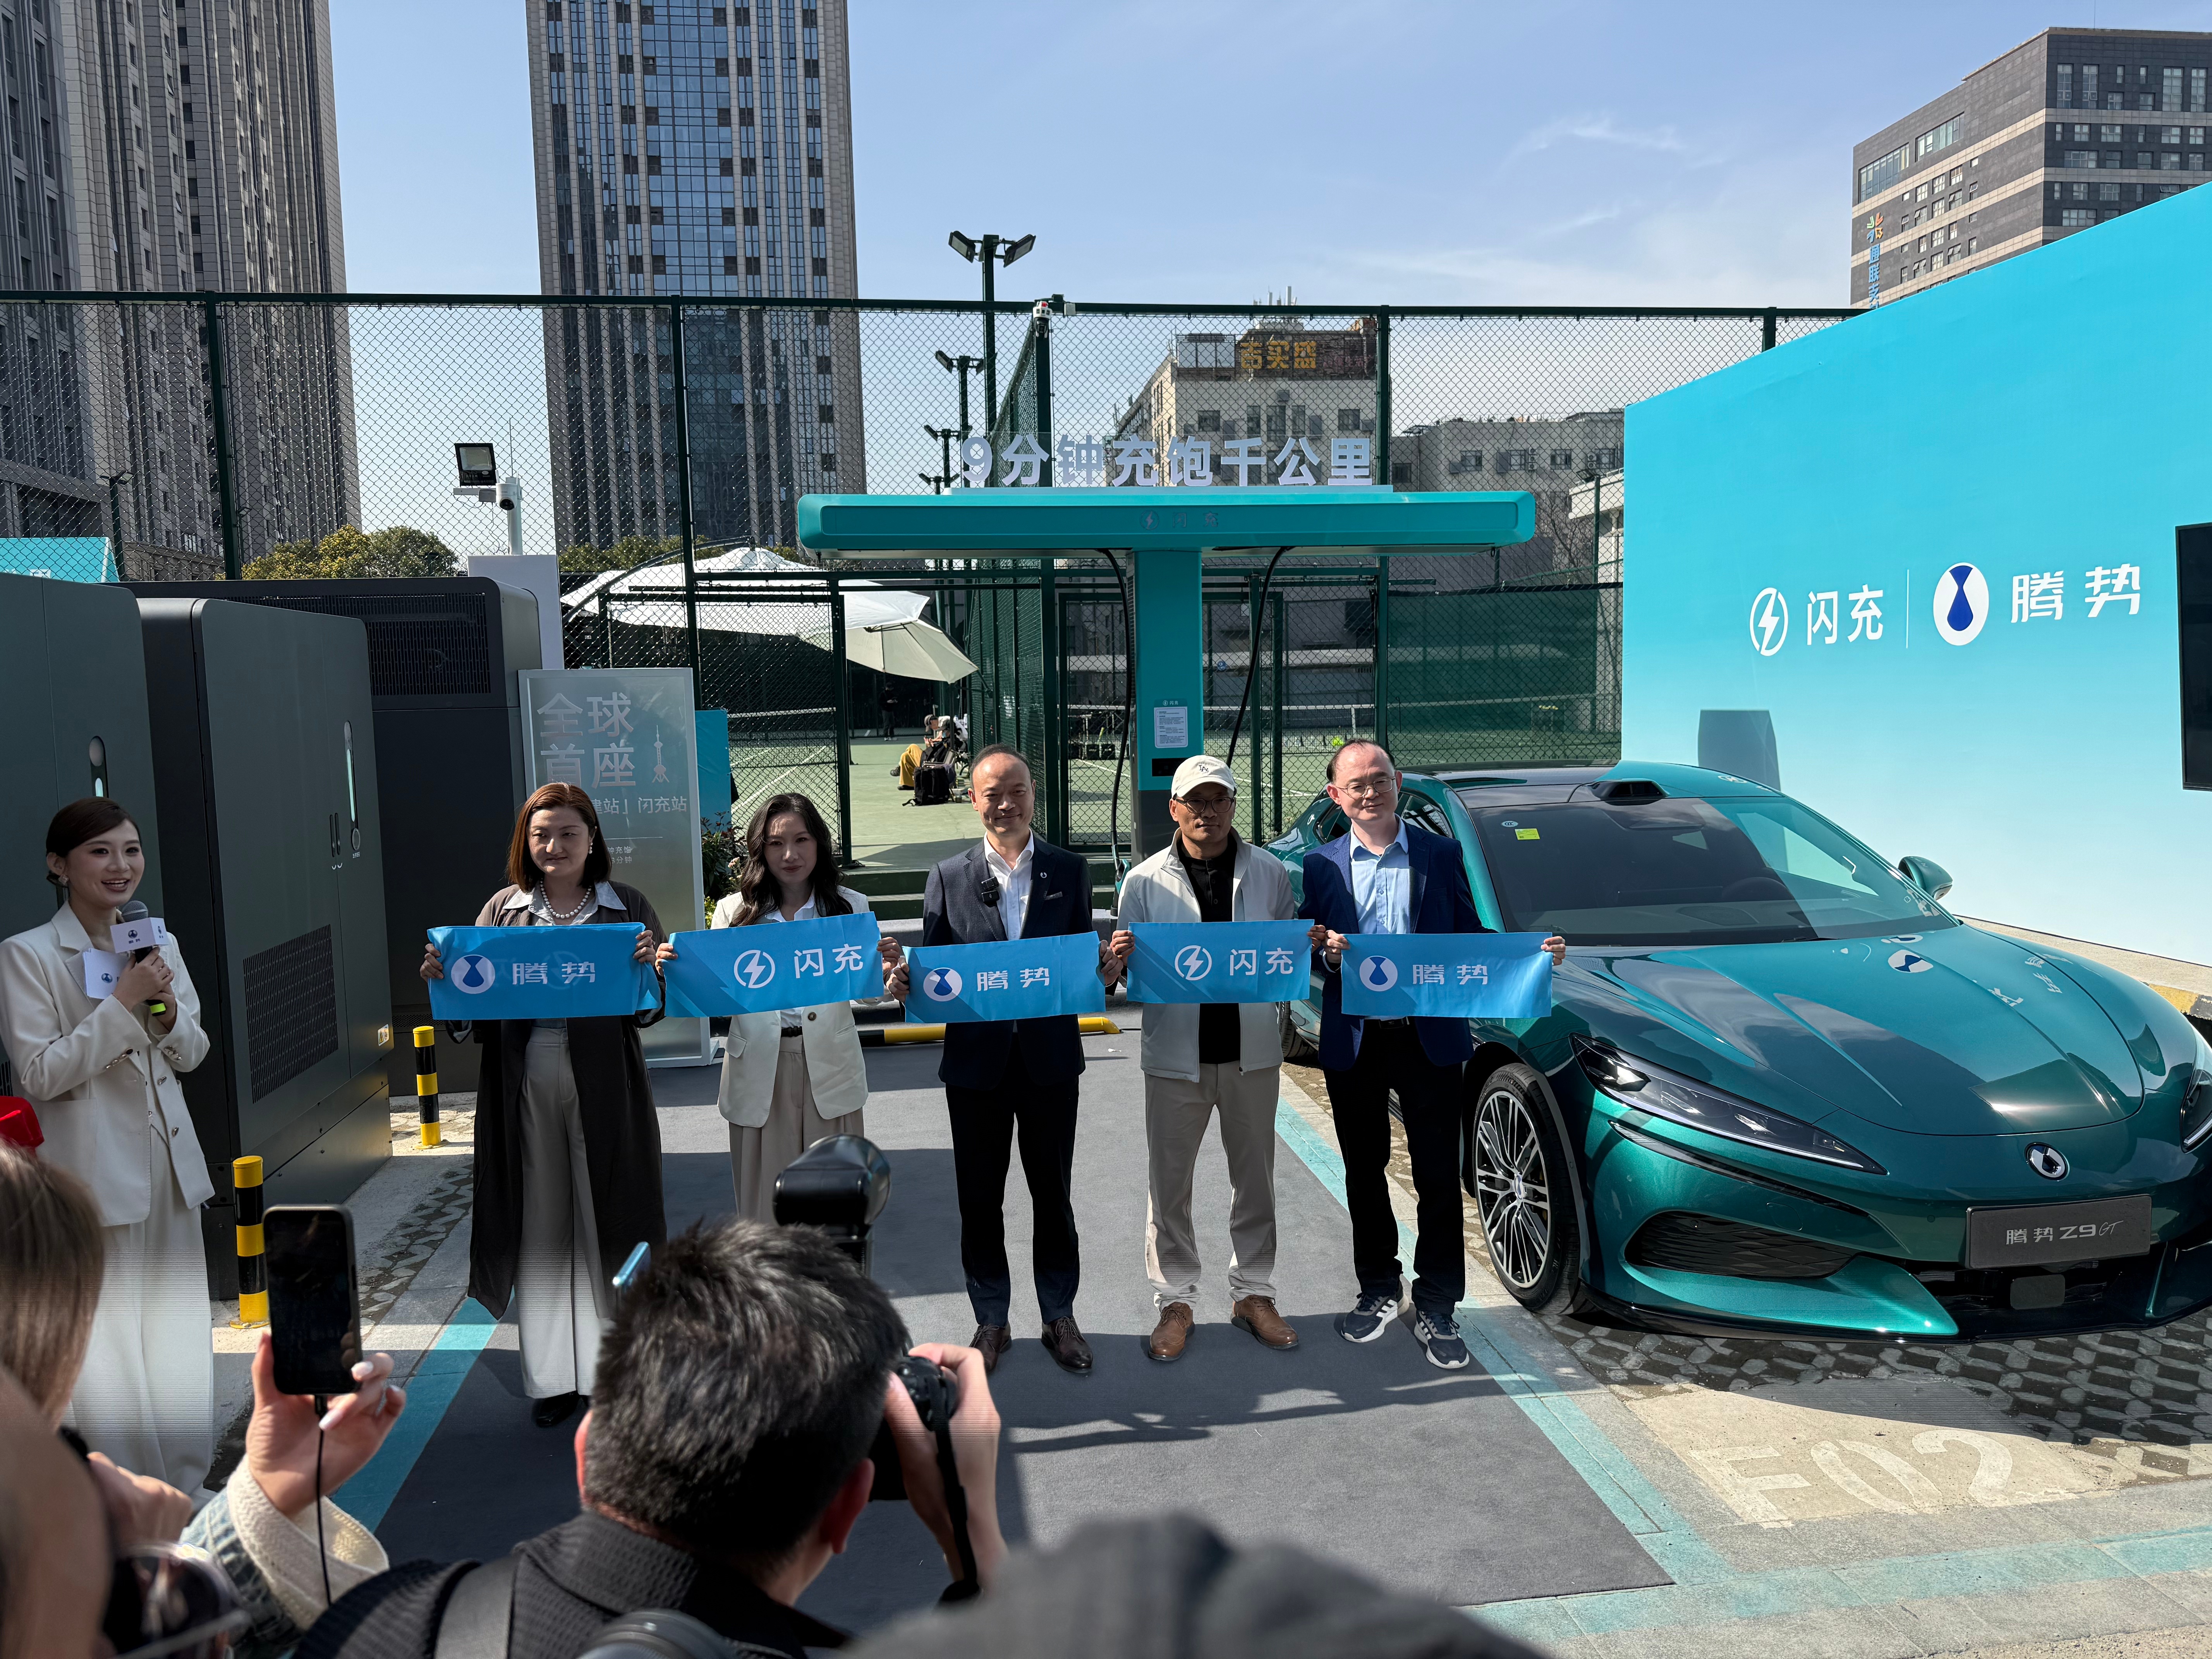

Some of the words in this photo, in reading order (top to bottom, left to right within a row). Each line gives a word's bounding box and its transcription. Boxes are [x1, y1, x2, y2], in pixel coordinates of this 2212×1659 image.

[962, 434, 1372, 487] 9分钟充饱千公里
[1173, 511, 1218, 527] 闪充
[2011, 563, 2140, 623] 腾势
[1807, 584, 1883, 645] 闪充
[537, 692, 634, 737] 全球
[541, 743, 636, 788] 首座
[512, 961, 595, 985] 腾势
[793, 944, 863, 978] 闪充
[1230, 948, 1293, 975] 闪充
[1412, 964, 1488, 985] 腾势
[977, 967, 1049, 991] 腾势
[2006, 1227, 2053, 1245] 腾势
